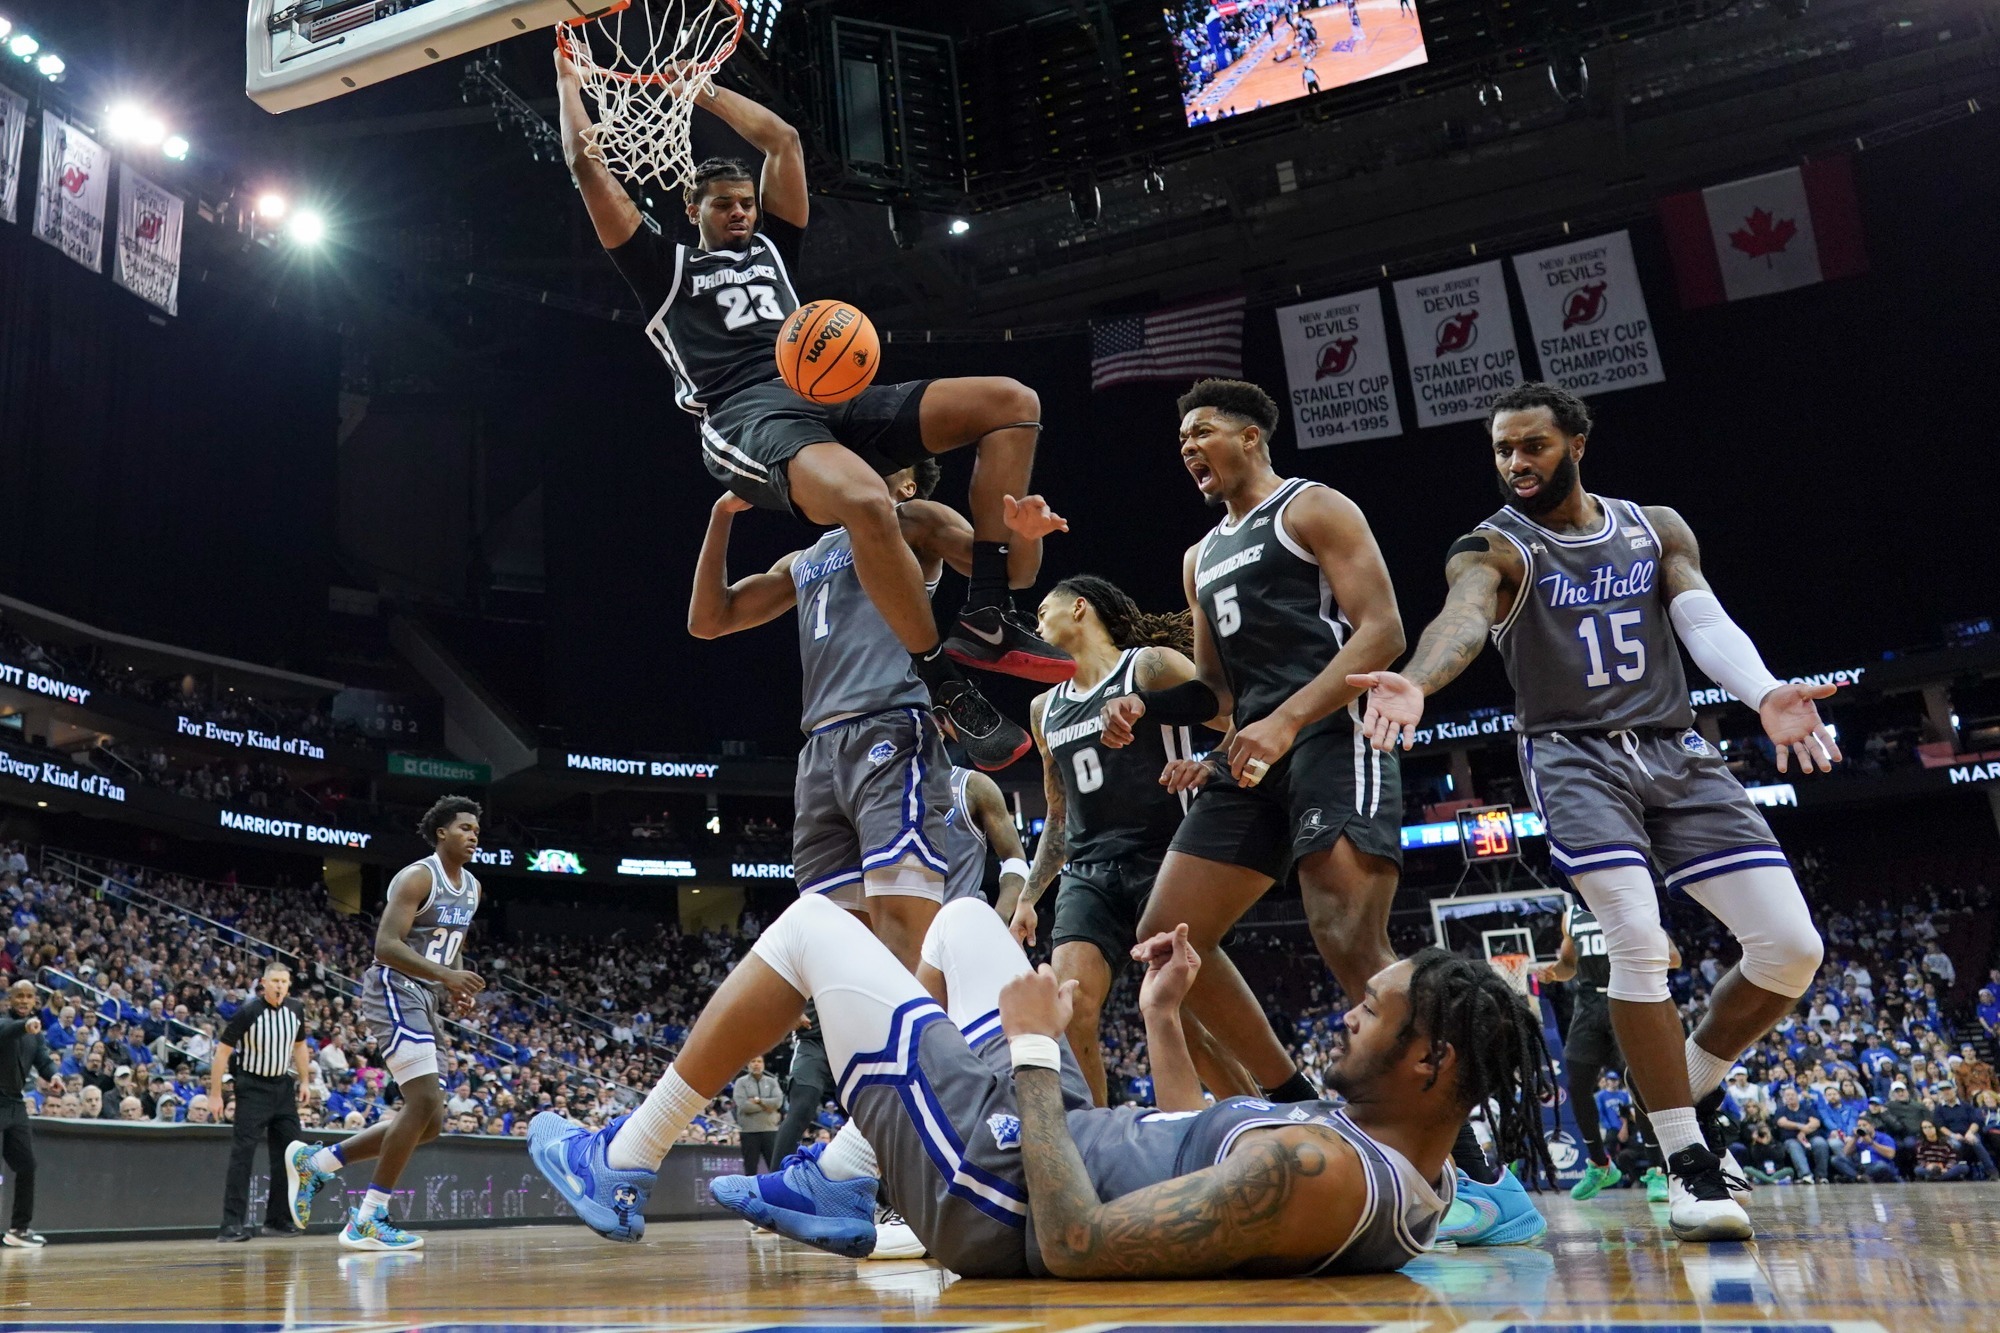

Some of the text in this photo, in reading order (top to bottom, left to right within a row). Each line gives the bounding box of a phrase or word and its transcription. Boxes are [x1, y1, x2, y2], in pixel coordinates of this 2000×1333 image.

[1540, 247, 1607, 270] NEW JERSEY
[1547, 261, 1606, 287] DEVILS
[691, 264, 777, 297] PROVIDENCE
[1416, 276, 1480, 298] NEW JERSEY
[716, 285, 785, 331] 23
[1298, 303, 1360, 324] NEW JERSEY
[1424, 290, 1480, 314] DEVILS
[787, 303, 821, 343] NCAA
[805, 308, 856, 364] Wilson
[1305, 317, 1359, 339] DEVILS
[1541, 320, 1647, 356] STANLEY CUP
[1414, 349, 1515, 383] STANLEY CUP
[1550, 341, 1648, 375] CHAMPIONS
[1293, 375, 1389, 406] STANLEY CUP
[1422, 370, 1515, 401] CHAMPIONS
[1558, 362, 1648, 390] 2002-2003
[1300, 395, 1389, 423] CHAMPIONS
[1430, 394, 1501, 417] 1999-20
[1307, 415, 1389, 438] 1994-1995
[797, 560, 820, 588] The
[1196, 543, 1265, 590] PROVIDENCE
[1539, 561, 1654, 607] The Hall
[815, 582, 830, 640] 1
[1213, 584, 1241, 637] 5
[1578, 610, 1645, 687] 15
[27, 672, 89, 704] BONVOY
[177, 716, 324, 759] For Every Kind of Fan
[1046, 715, 1103, 750] PROVIDEN
[1435, 719, 1479, 739] Kind
[1481, 716, 1500, 734] of
[0, 752, 125, 801] Every Kind of Fan
[419, 760, 476, 781] Citizens
[567, 753, 719, 778] MARRIOTT BONVOY
[1072, 747, 1104, 794] 0
[220, 810, 371, 849] MARRIOTT BONVOY
[1473, 829, 1508, 855] 30
[471, 847, 498, 864] For
[731, 863, 794, 878] MARRIO
[437, 906, 473, 926] The Hall
[425, 927, 463, 965] 20
[1579, 934, 1607, 957] 10
[424, 1174, 493, 1219] Kind
[502, 1173, 532, 1218] of
